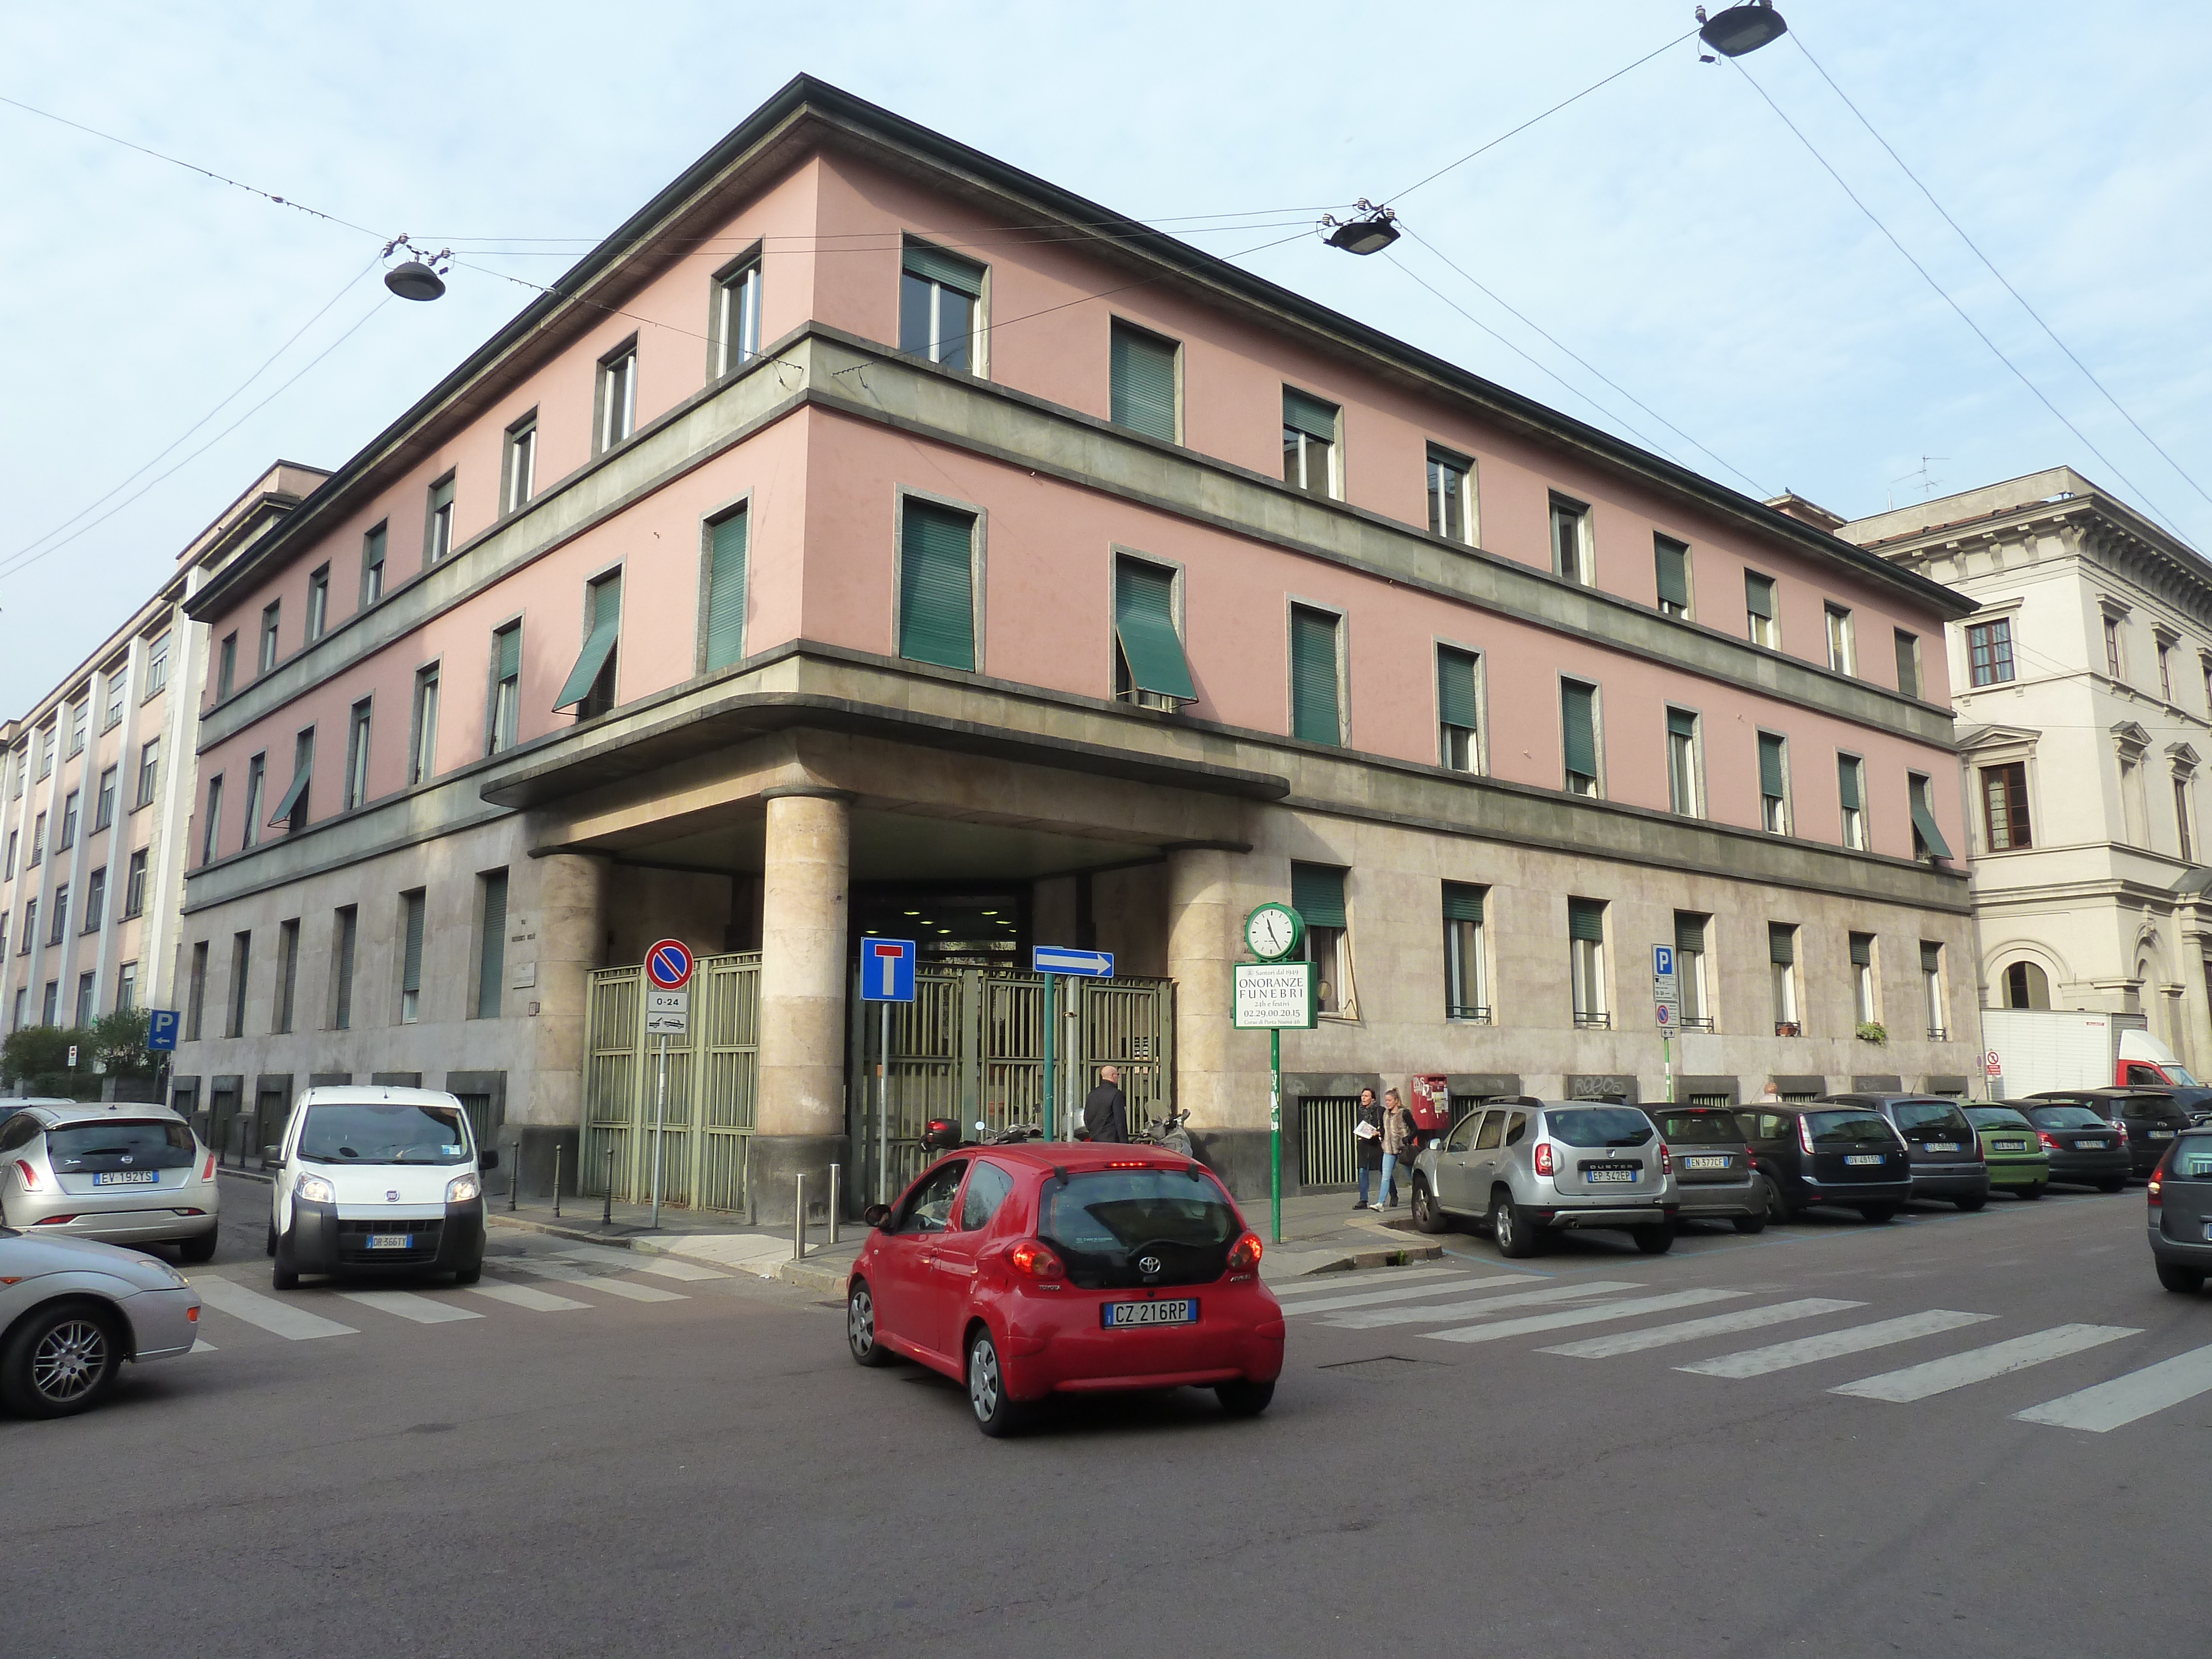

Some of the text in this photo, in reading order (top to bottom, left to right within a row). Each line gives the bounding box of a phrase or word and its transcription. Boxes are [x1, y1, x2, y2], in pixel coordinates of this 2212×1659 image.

[1659, 951, 1669, 971] P
[1239, 978, 1303, 988] ONORANZE
[1240, 988, 1303, 999] FUNEBRI
[656, 998, 679, 1006] 0-24
[1244, 1010, 1300, 1018] 02.29.00.20.15
[155, 1013, 174, 1032] P
[1691, 1159, 1700, 1167] EN
[102, 1171, 152, 1183] EV 192YS
[1593, 1171, 1630, 1181] EP 342EP
[1116, 1306, 1134, 1323] CZ
[1140, 1302, 1187, 1321] 216RP
